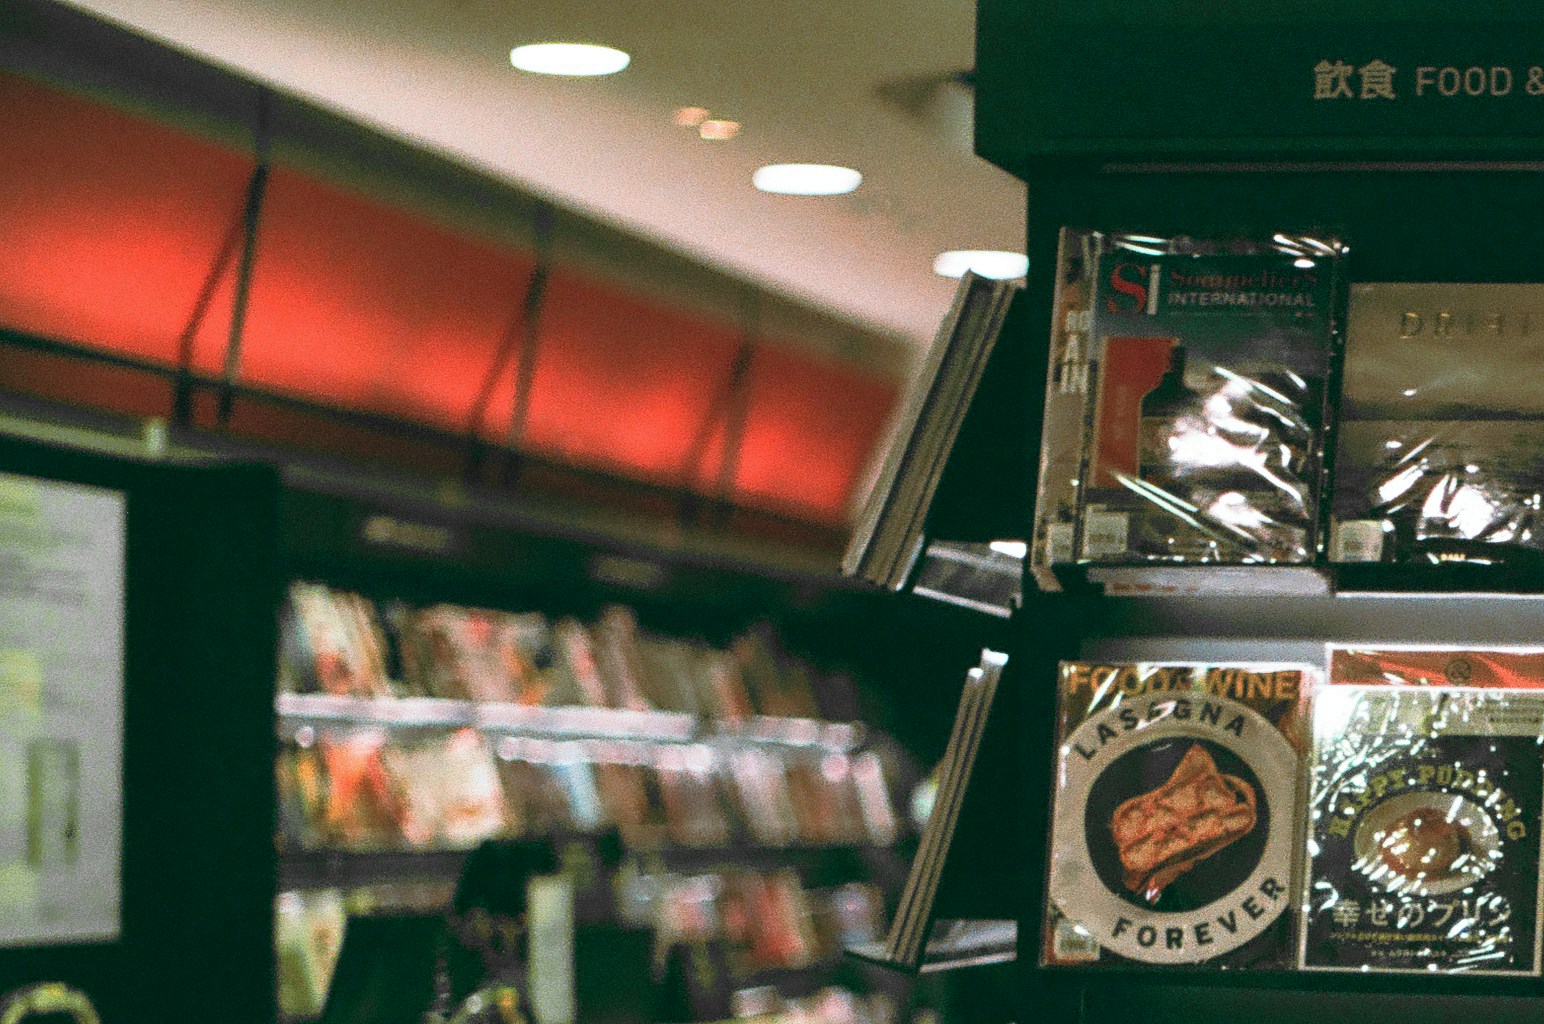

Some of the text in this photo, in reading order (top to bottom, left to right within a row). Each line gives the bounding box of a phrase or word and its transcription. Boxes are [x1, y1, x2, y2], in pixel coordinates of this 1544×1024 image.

[1313, 60, 1397, 100] 飲食
[1415, 67, 1511, 96] FOOD
[1168, 291, 1316, 307] INTERNATIONAL
[1111, 876, 1287, 950] FOREVER
